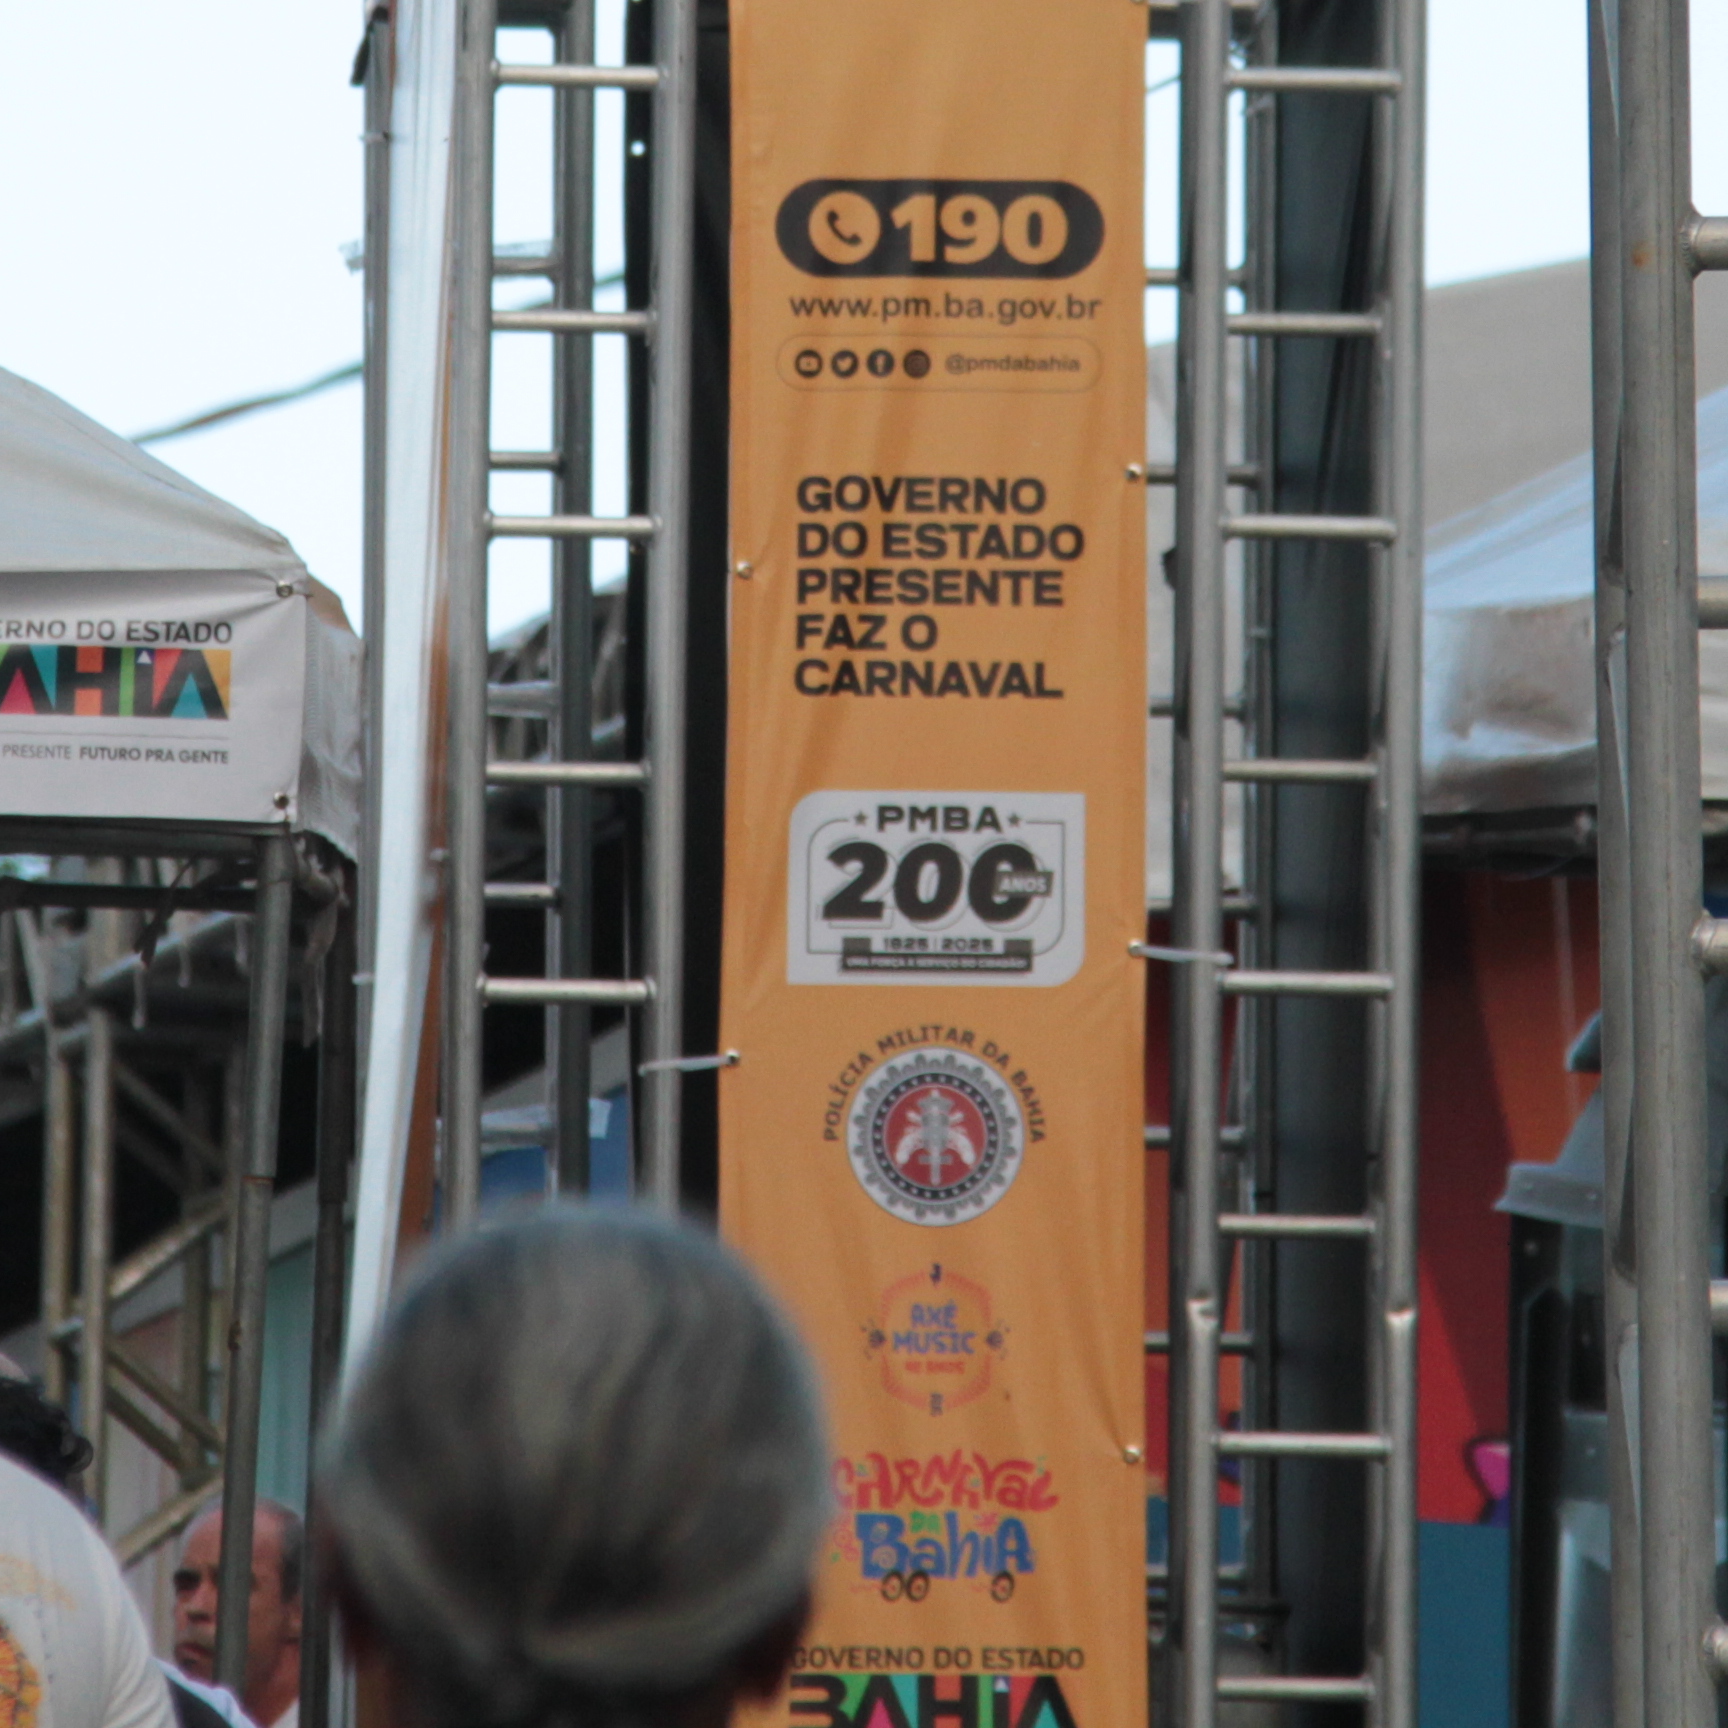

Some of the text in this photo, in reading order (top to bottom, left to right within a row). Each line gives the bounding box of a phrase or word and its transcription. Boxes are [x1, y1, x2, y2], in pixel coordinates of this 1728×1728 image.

[890, 192, 1069, 266] 190
[789, 292, 1102, 325] www.pm.ba.gov.br
[796, 475, 1047, 515] GOVERNO
[797, 522, 1085, 561] DO ESTADO
[796, 568, 1065, 607] PRESENTE
[76, 620, 116, 642] DO
[125, 621, 233, 644] ESTADO
[795, 614, 939, 651] FAZ O
[793, 659, 1065, 699] CARNAVAL
[3, 744, 72, 760] PRESENTE
[79, 746, 142, 762] FUTURO
[145, 747, 176, 763] PRA
[179, 749, 230, 765] GENTE
[876, 805, 1003, 833] PMBA
[822, 841, 1038, 924] 200
[941, 938, 994, 953] 2025
[823, 1025, 1046, 1144] POLÍCIA MILITAR DA BAHIA
[892, 1331, 977, 1355] MUSIC
[792, 1646, 1085, 1672] GOVERNO DO ESTADO
